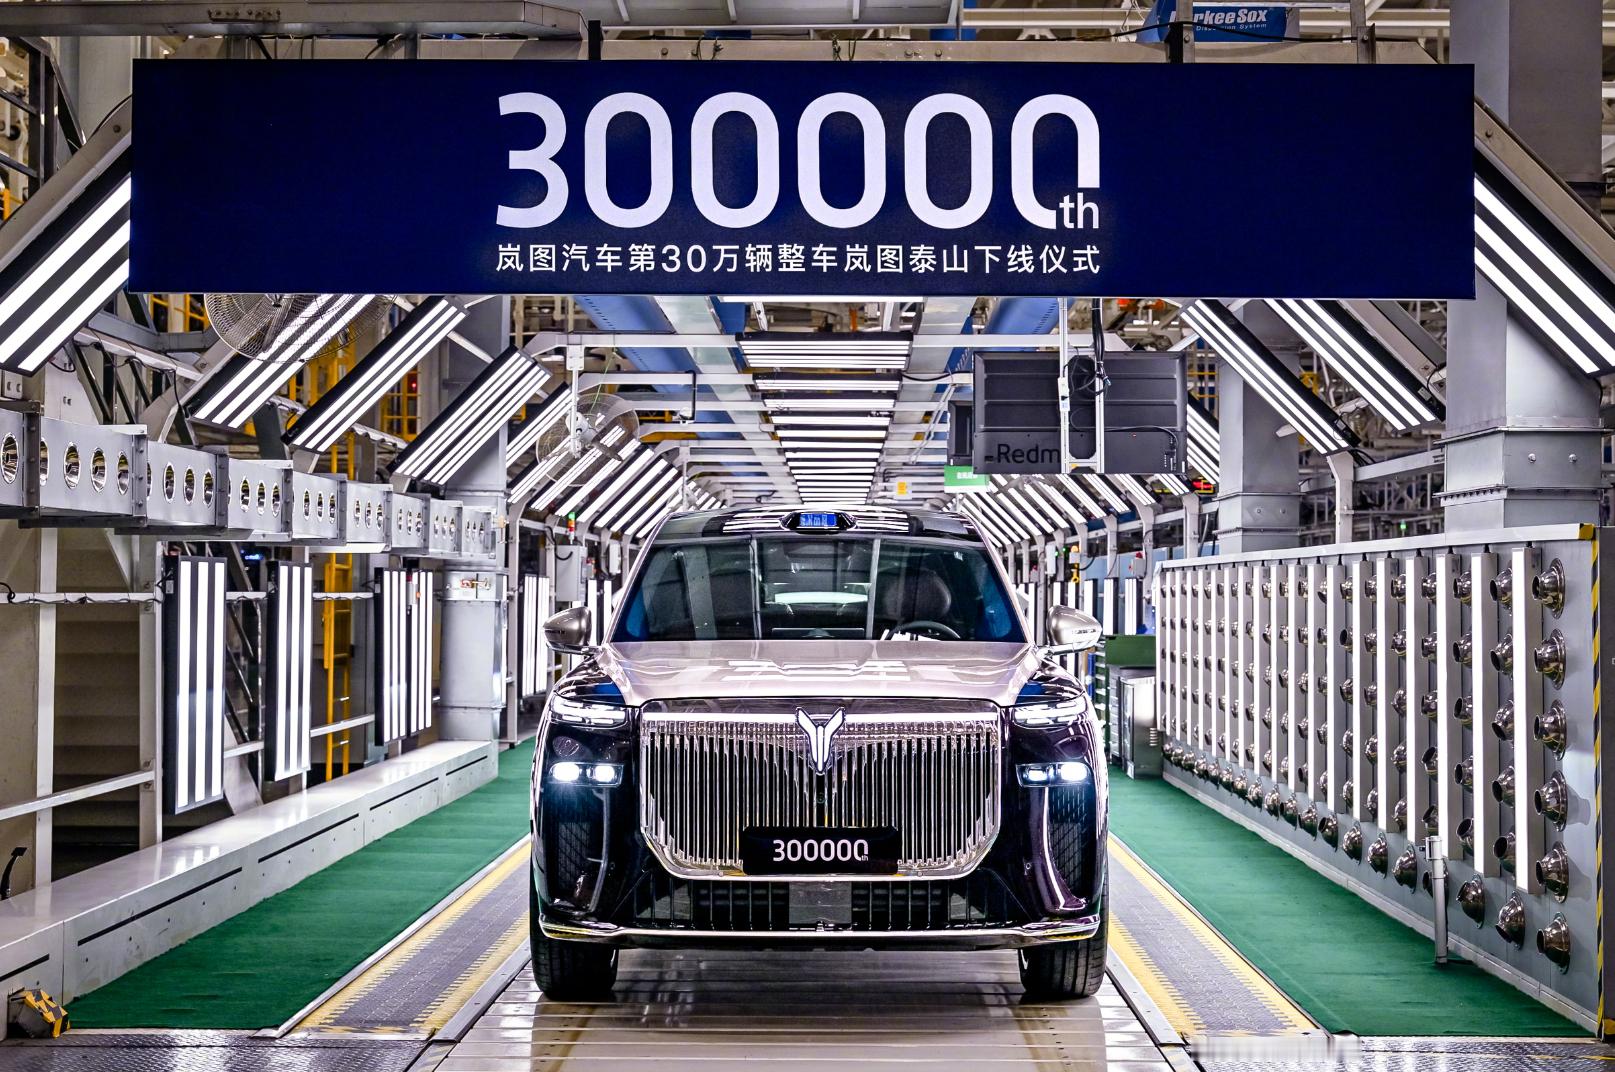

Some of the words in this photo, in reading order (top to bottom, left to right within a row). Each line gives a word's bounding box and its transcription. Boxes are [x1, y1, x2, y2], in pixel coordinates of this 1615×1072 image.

[496, 244, 1100, 273] 岚图汽车第30万辆整车岚图泰山下线仪式
[997, 443, 1061, 464] Redm
